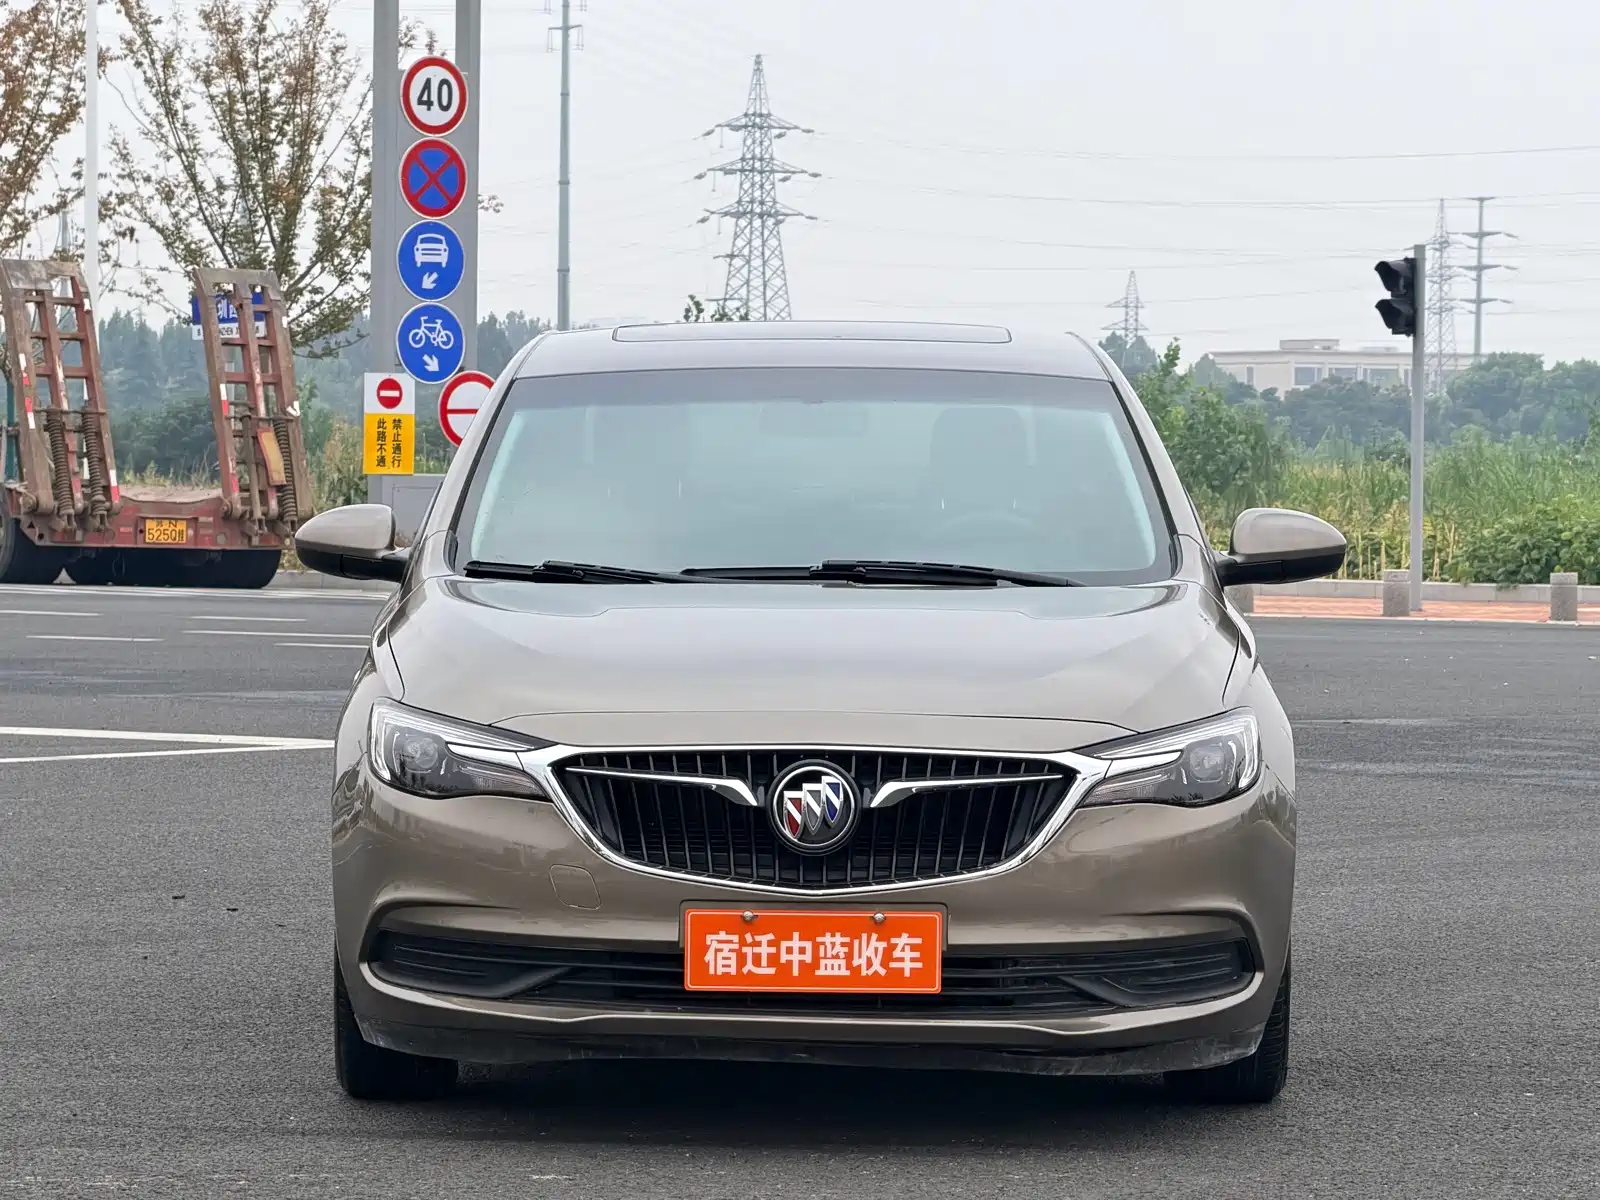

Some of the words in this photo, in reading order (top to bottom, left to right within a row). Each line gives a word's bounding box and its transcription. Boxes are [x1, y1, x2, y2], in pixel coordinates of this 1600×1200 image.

[417, 77, 453, 112] 40
[376, 418, 387, 467] 此路不通
[392, 418, 402, 468] 禁止通行
[704, 931, 923, 977] 宿迁中蓝收车
